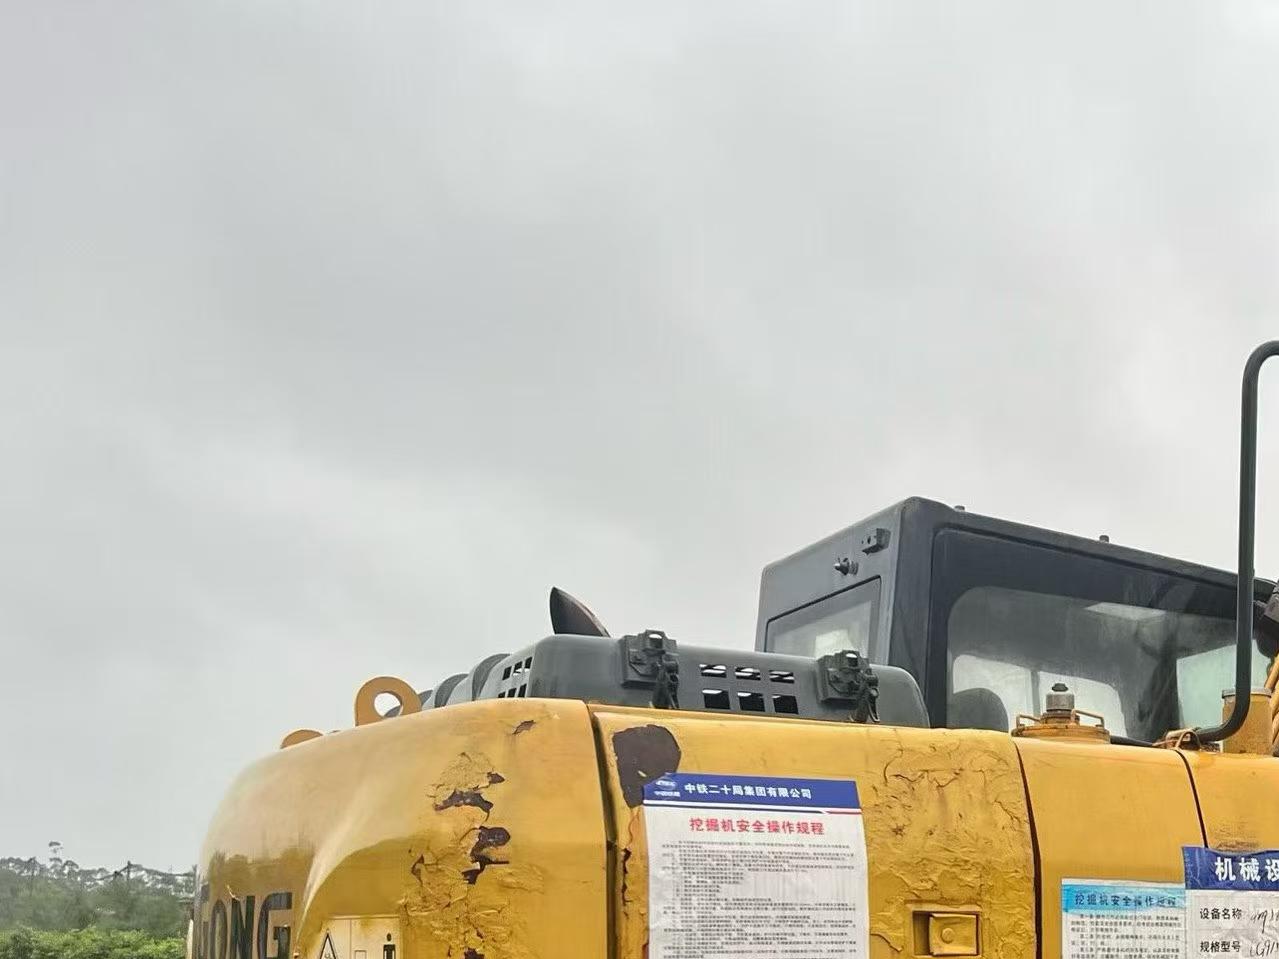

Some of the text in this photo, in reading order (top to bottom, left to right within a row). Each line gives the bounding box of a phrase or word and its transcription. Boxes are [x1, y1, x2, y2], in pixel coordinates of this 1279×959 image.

[684, 782, 812, 799] 中铁二十局集团有限公司
[689, 817, 825, 836] 挖掘机安全操作规程
[1199, 908, 1243, 920] 设备名称
[1199, 940, 1242, 953] 规格型号
